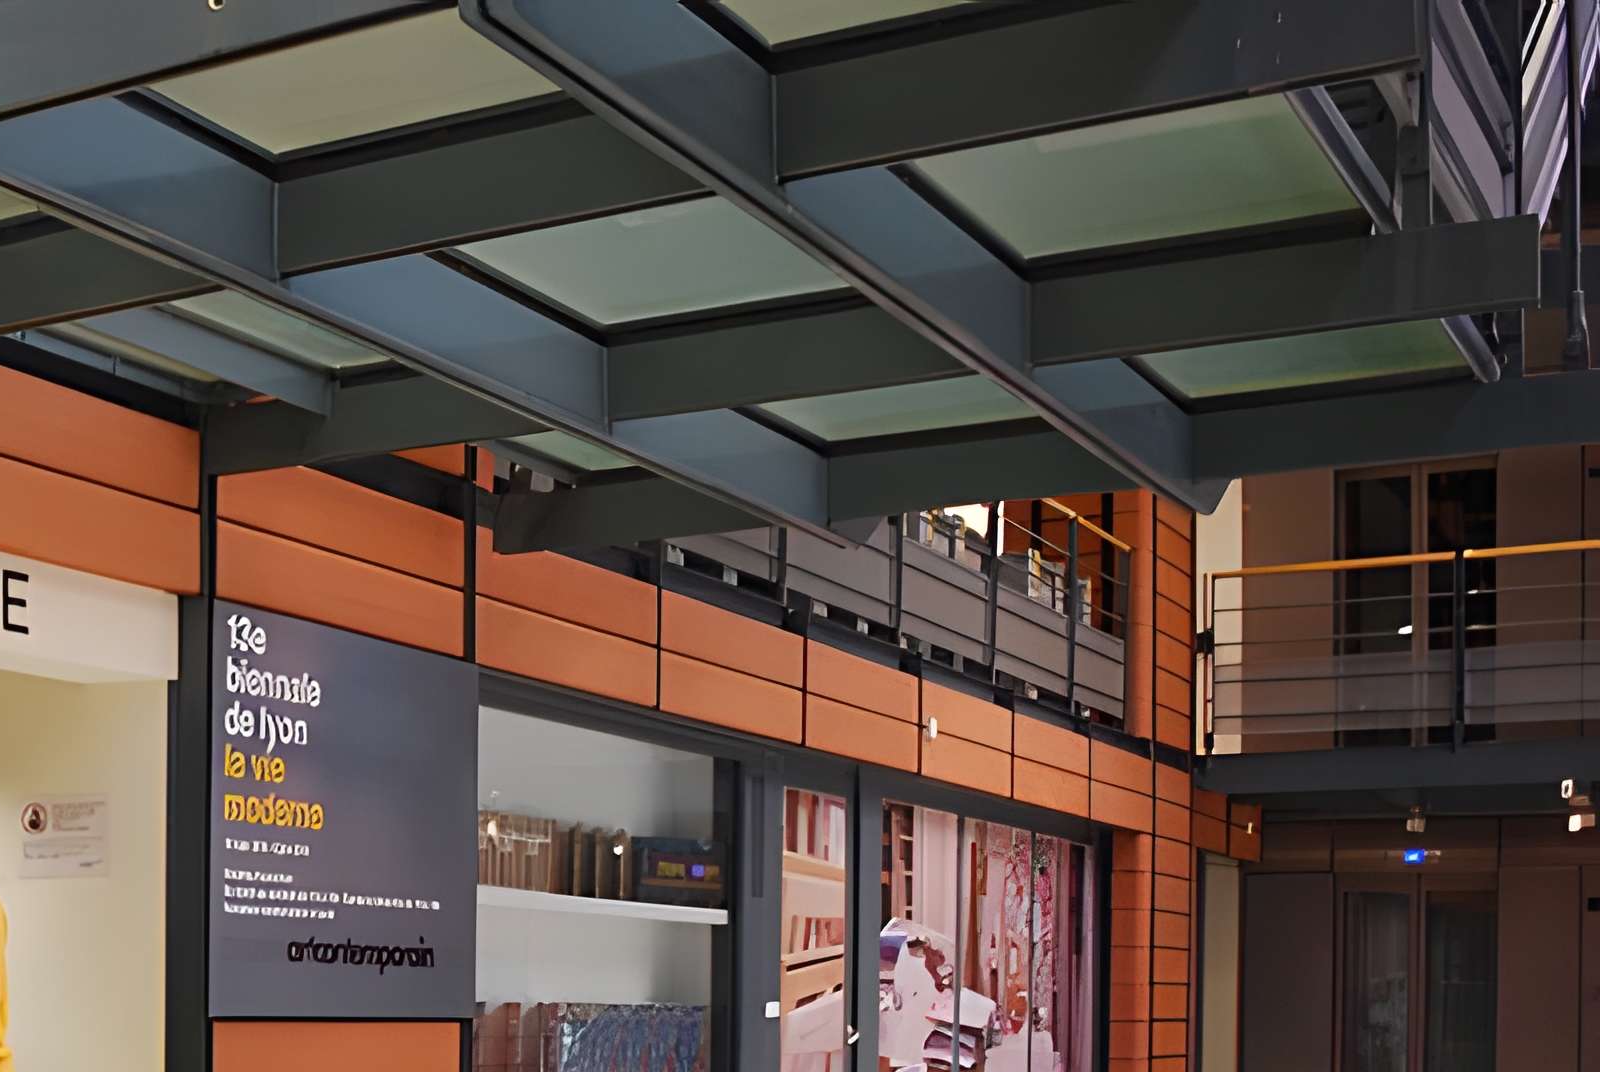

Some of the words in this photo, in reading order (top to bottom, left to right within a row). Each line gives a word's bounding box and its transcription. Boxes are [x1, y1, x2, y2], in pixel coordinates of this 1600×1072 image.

[226, 656, 321, 707] biennale
[225, 700, 255, 738] de
[259, 705, 308, 754] lyon
[224, 743, 246, 778] la
[251, 754, 285, 783] vie
[224, 792, 324, 831] moderne
